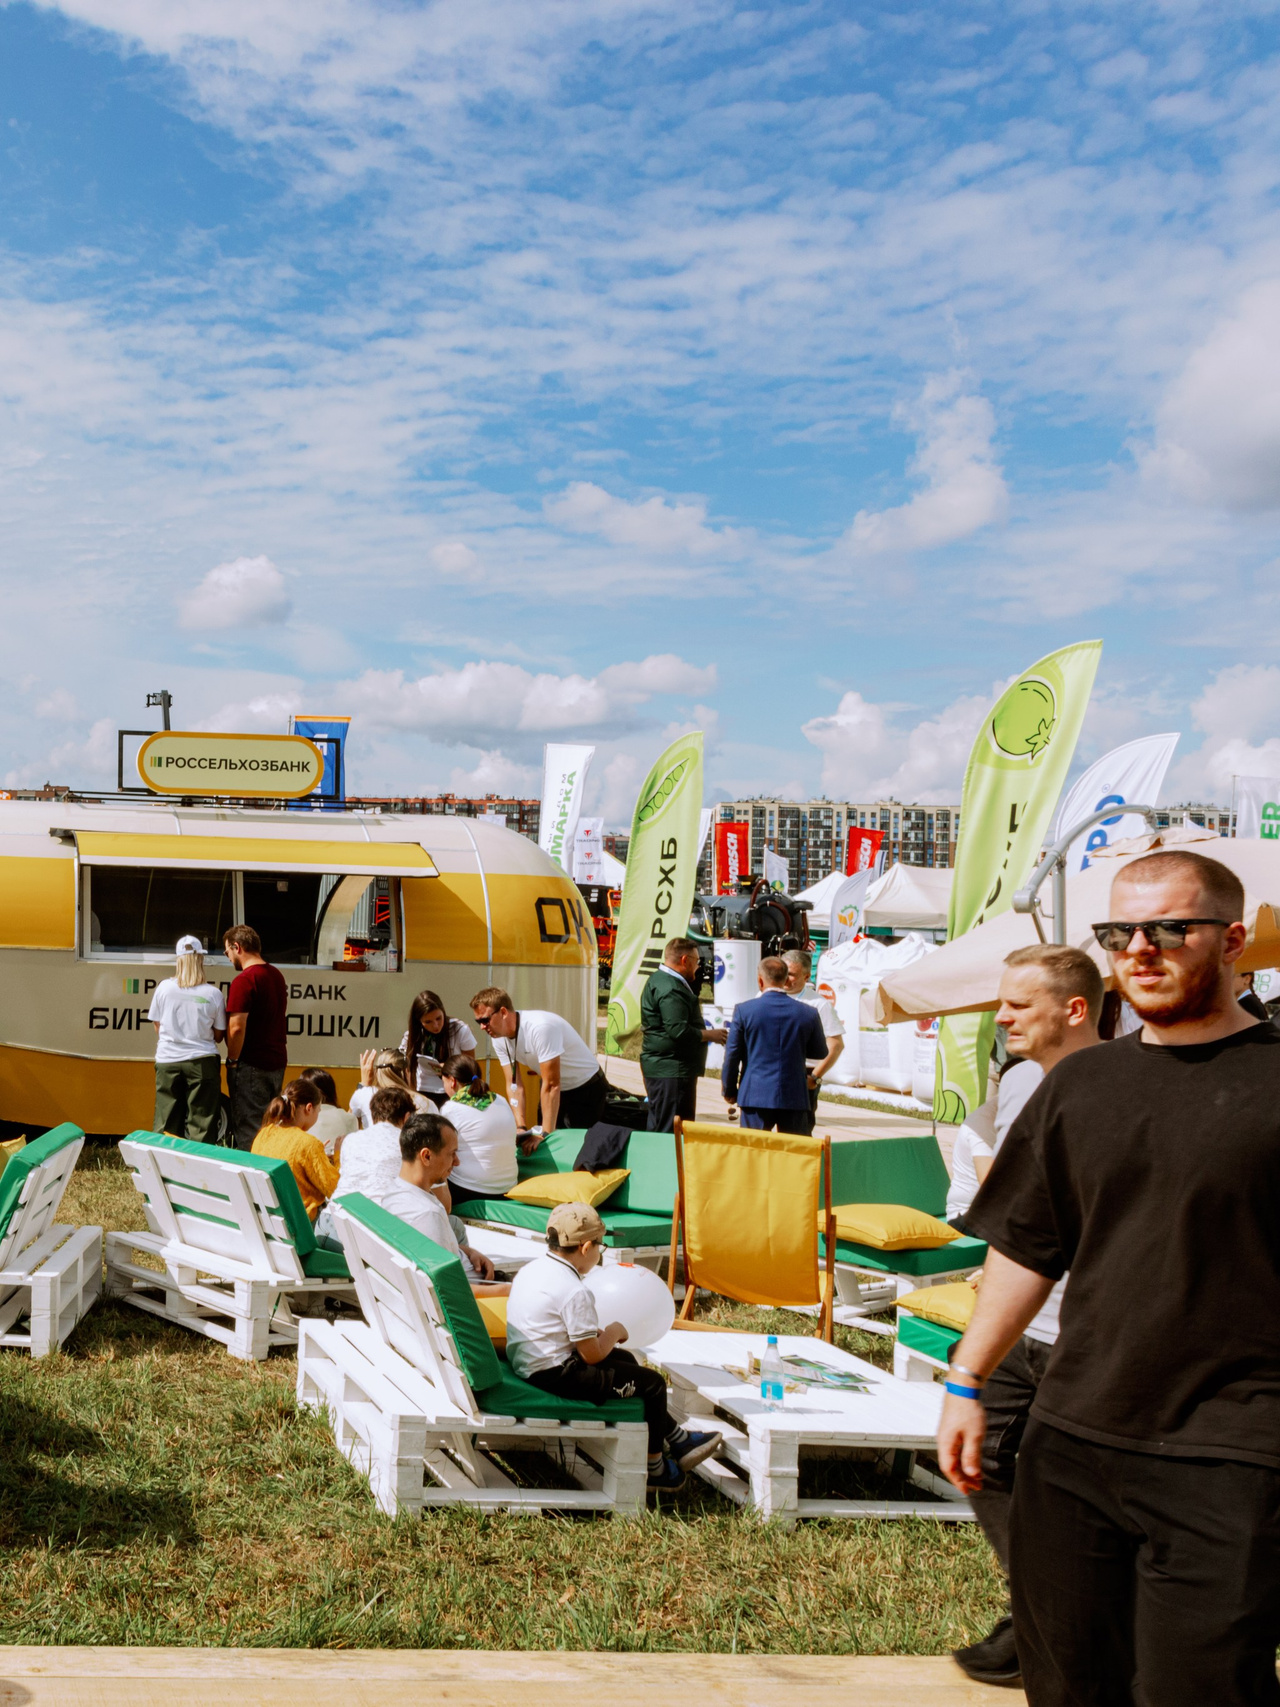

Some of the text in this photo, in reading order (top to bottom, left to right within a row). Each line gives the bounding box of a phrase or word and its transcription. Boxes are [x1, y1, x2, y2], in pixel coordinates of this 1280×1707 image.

[166, 756, 311, 773] РОССЕЛЬХОЗБАНК
[859, 837, 872, 872] RSCH
[650, 837, 678, 939] РСХБ
[89, 1006, 380, 1038] БИР ОШКИ
